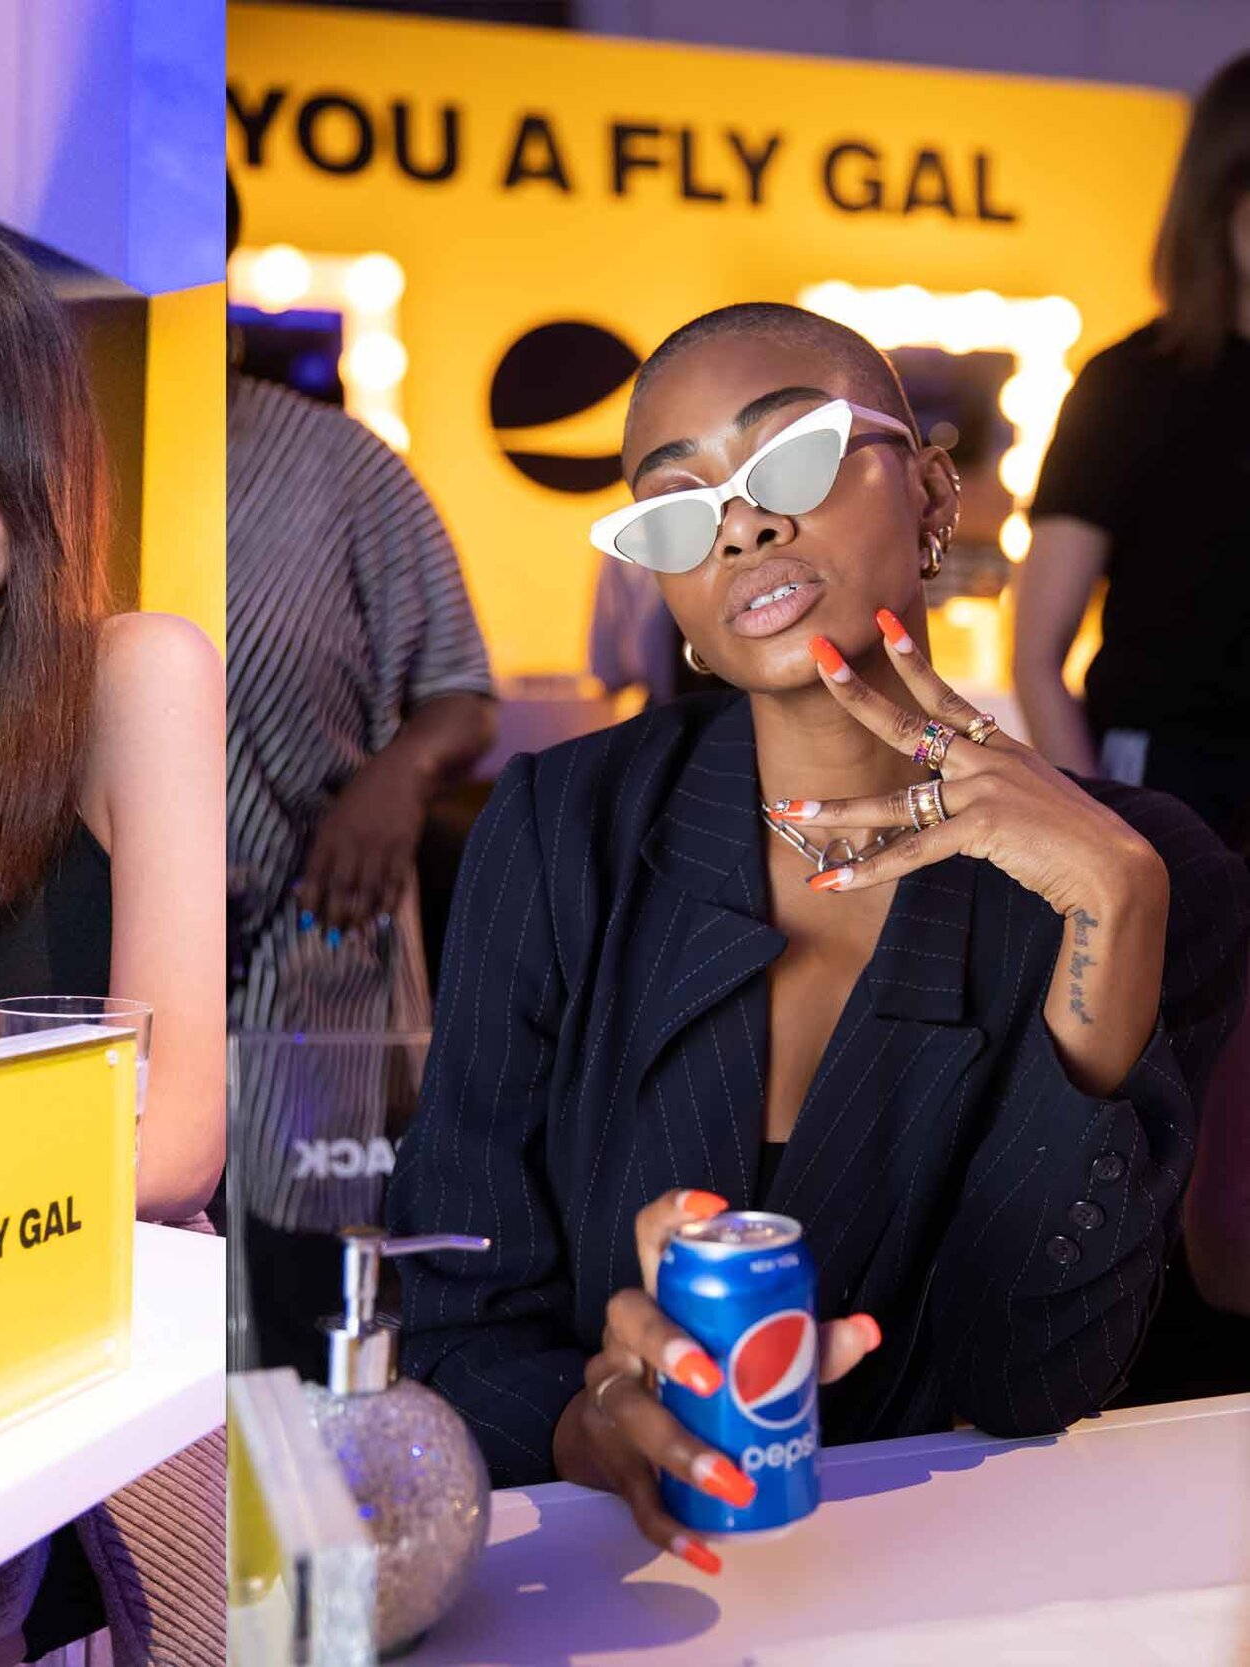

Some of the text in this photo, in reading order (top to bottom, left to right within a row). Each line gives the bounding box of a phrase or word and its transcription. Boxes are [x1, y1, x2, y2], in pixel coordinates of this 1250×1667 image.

[226, 84, 1017, 224] YOU A FLY GAL
[19, 1196, 82, 1249] GAL
